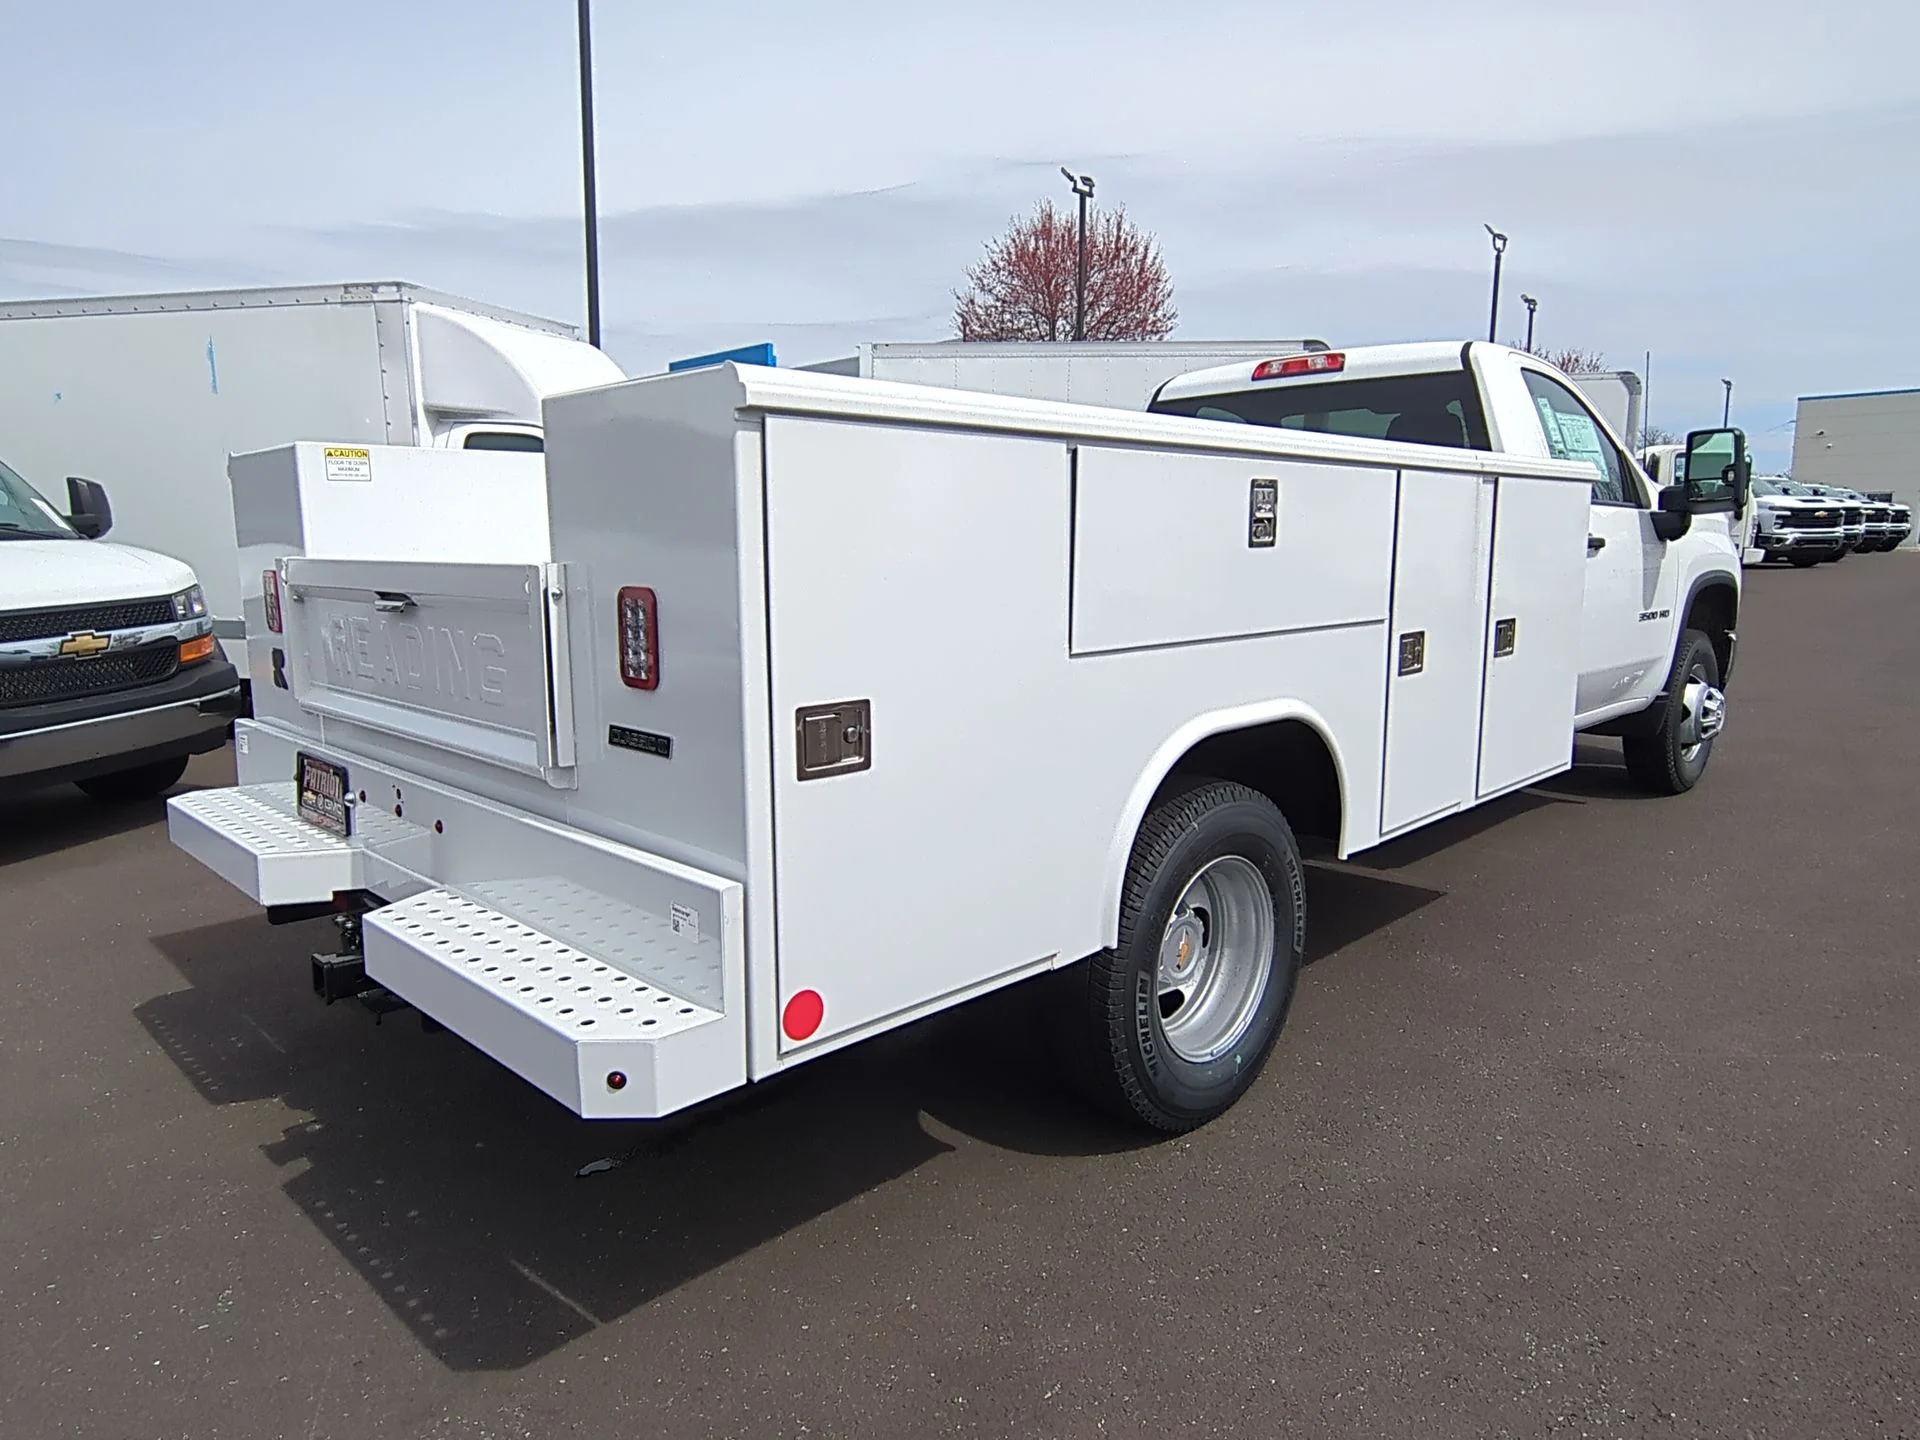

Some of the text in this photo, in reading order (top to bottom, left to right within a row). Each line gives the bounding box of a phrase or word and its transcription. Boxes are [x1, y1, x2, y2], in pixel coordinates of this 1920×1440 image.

[333, 449, 368, 458] CAUTION
[1638, 609, 1670, 622] 3500 HD
[326, 613, 508, 706] READING
[303, 765, 341, 800] PATRIOT
[1285, 856, 1304, 949] MICHELIN
[1138, 977, 1159, 1077] MICHELIN
